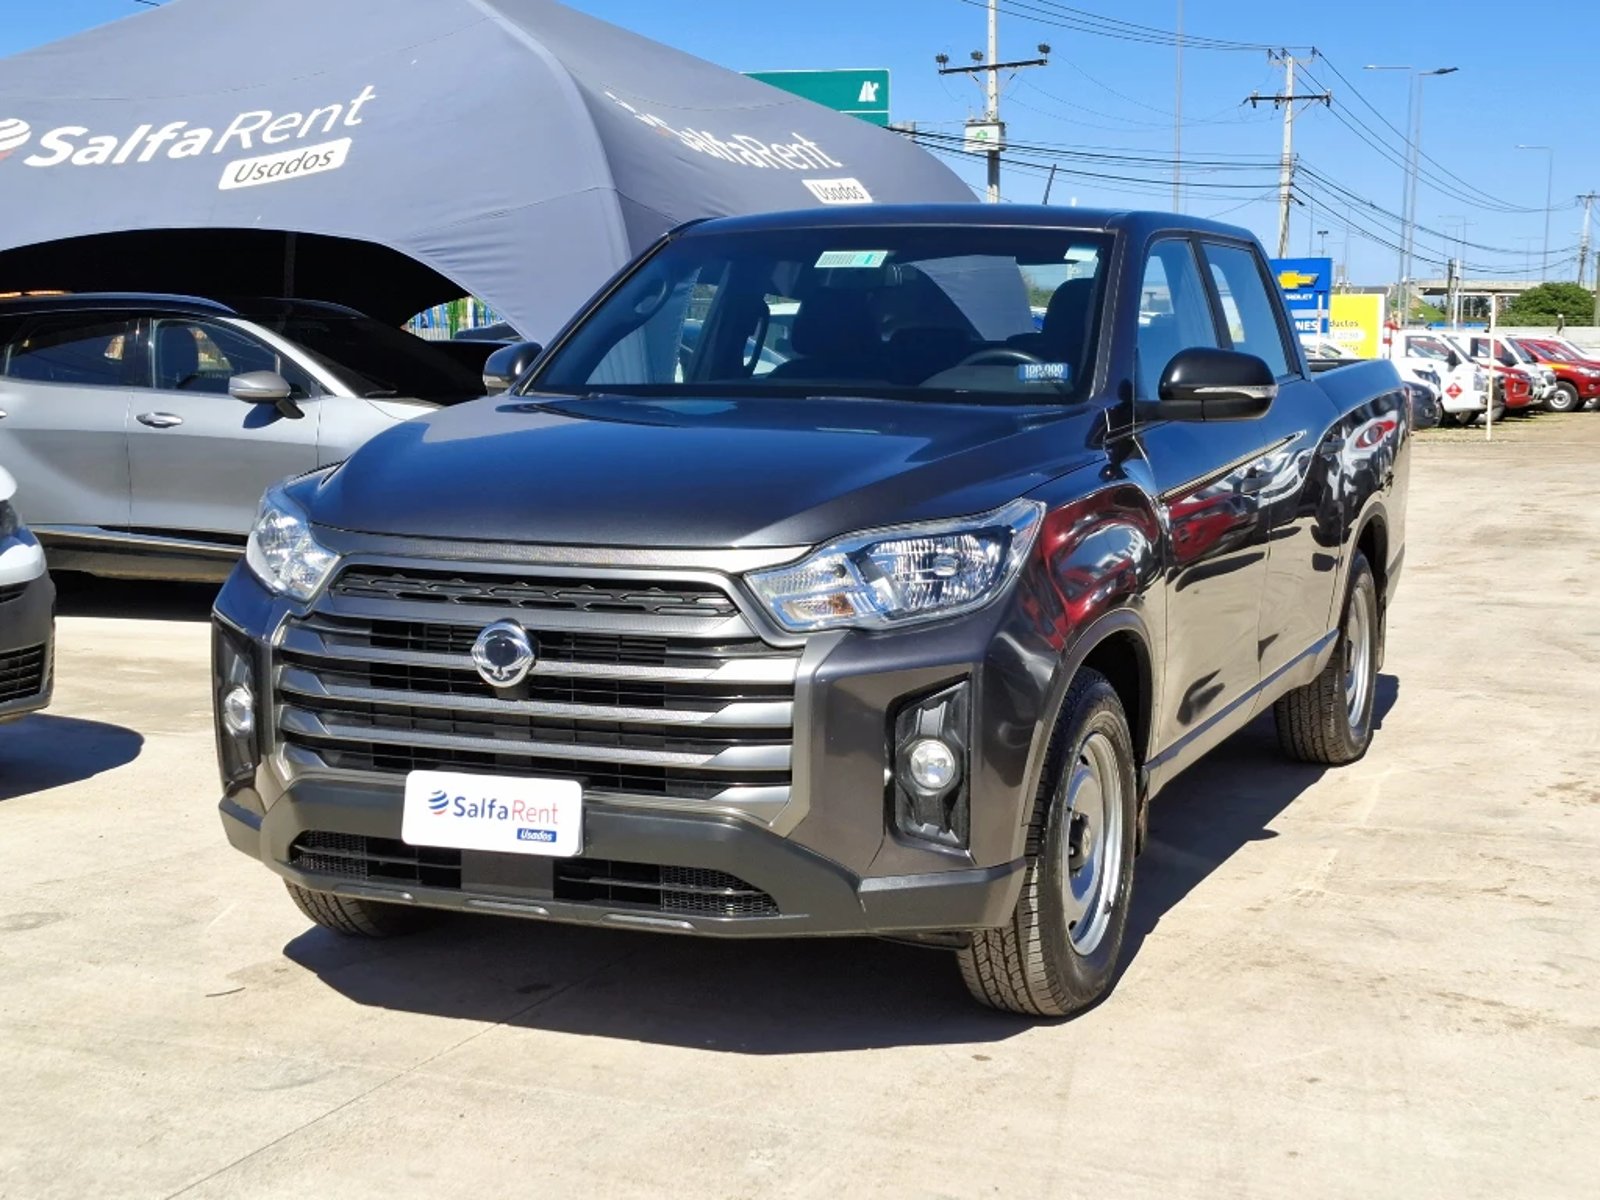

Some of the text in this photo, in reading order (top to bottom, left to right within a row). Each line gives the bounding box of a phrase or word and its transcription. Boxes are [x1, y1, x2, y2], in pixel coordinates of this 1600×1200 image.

[24, 85, 376, 167] SalfaRent
[679, 127, 843, 170] SalfaRent
[233, 149, 335, 183] Usados
[811, 182, 866, 201] Usados
[453, 796, 559, 825] SalfaRent
[520, 829, 553, 842] Usados
